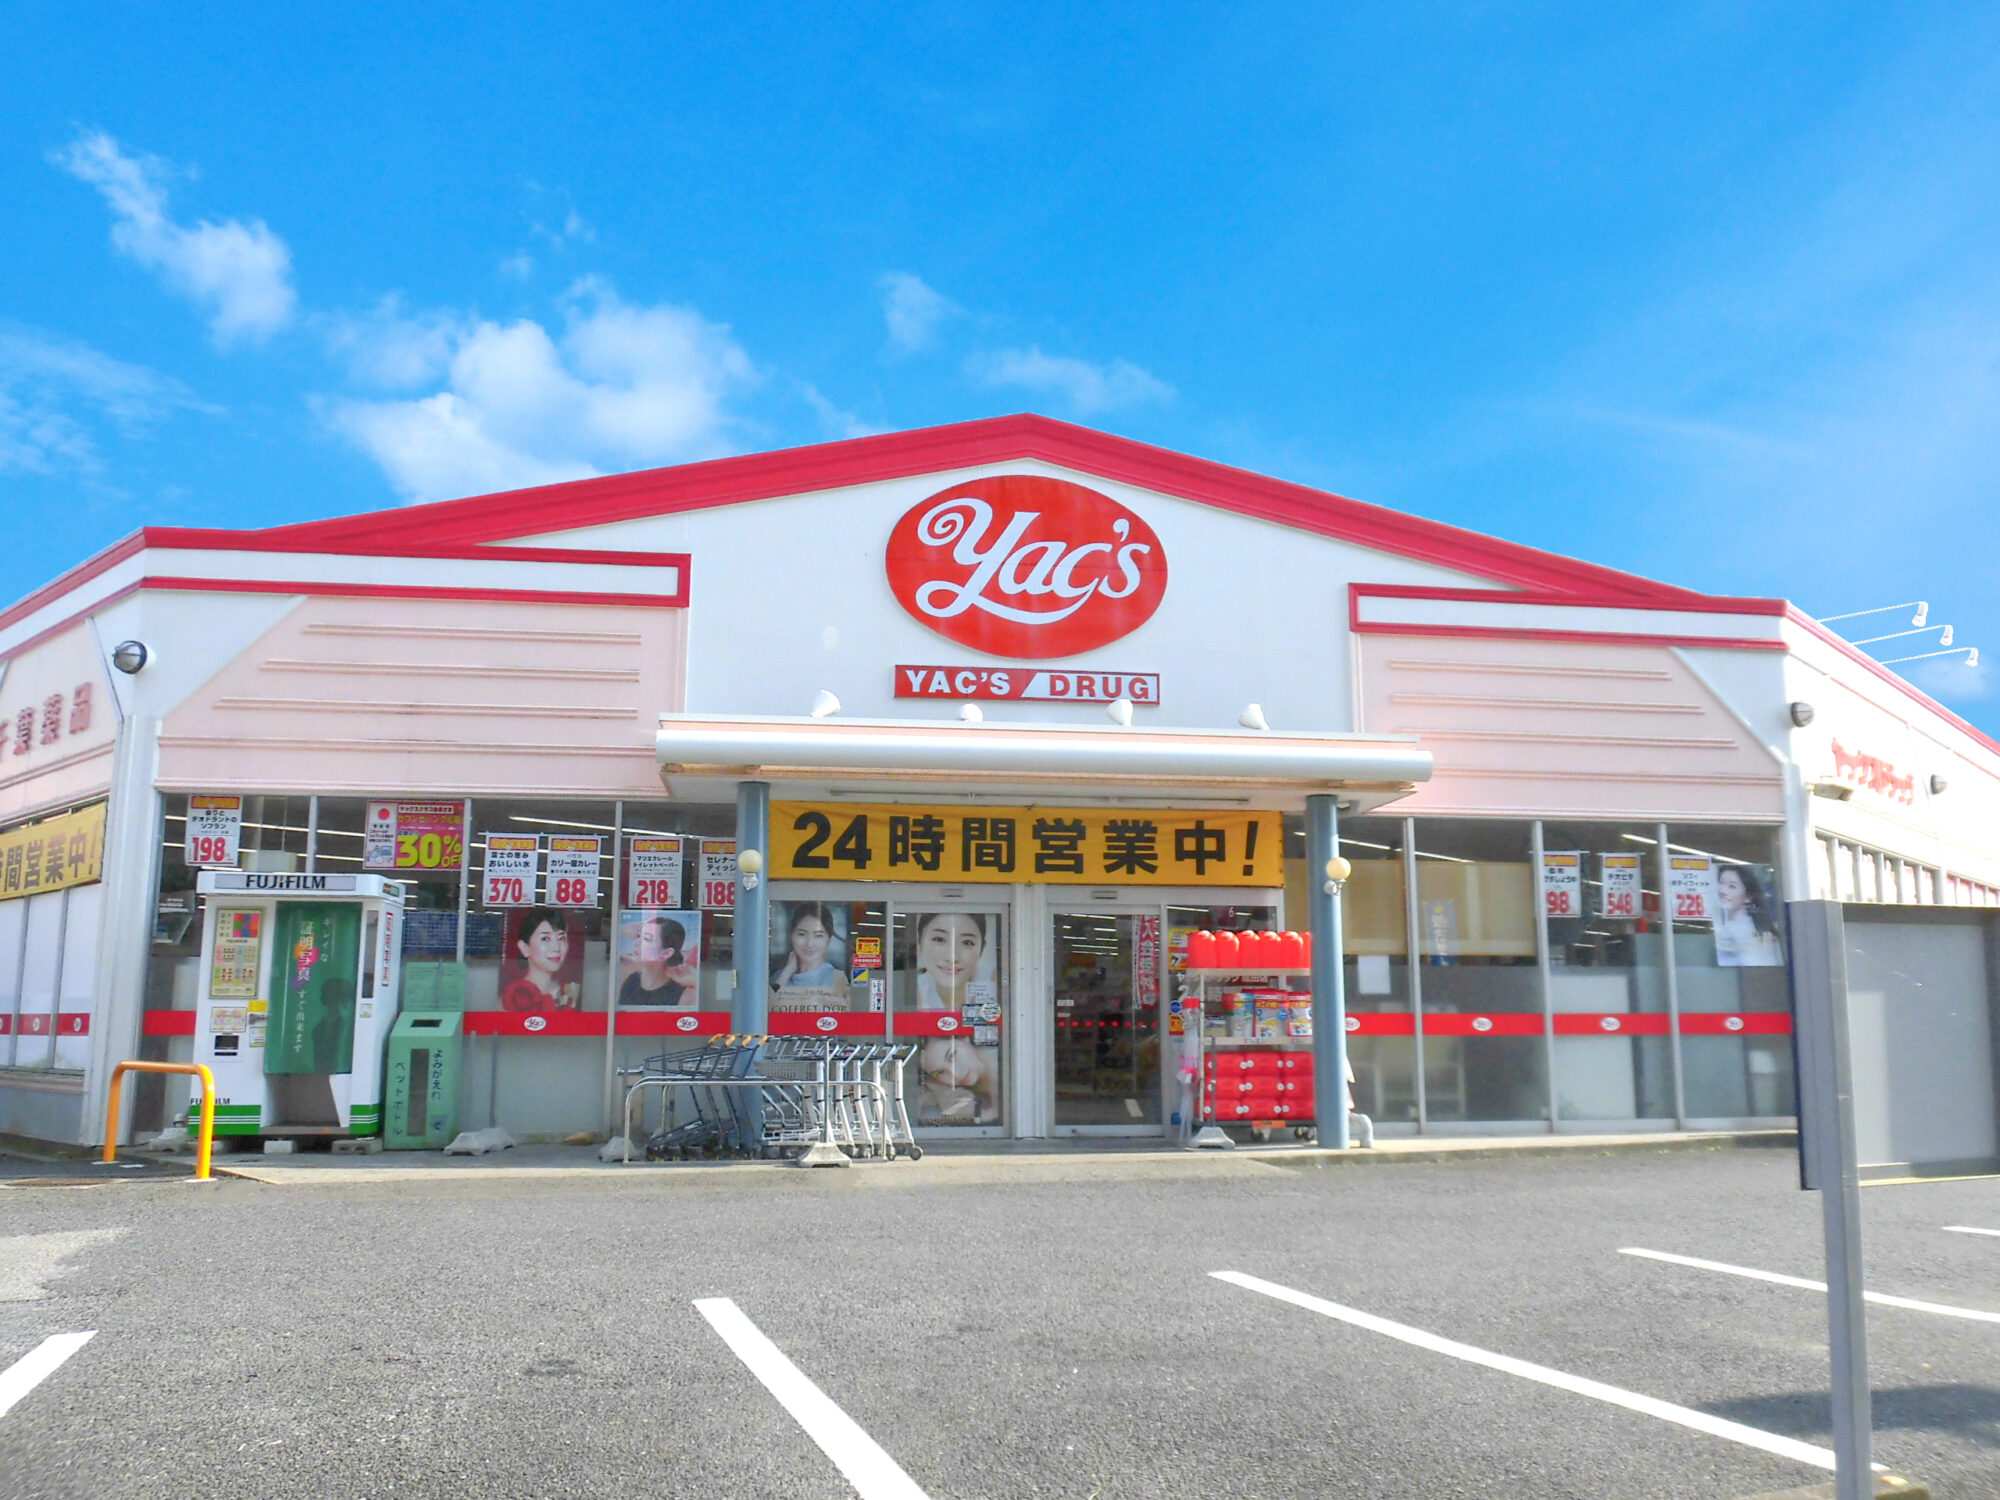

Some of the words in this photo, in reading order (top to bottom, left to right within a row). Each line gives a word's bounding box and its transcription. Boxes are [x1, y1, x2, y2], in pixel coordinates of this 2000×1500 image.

[915, 497, 1150, 625] Yac's
[905, 670, 1010, 695] YAC'S
[1049, 675, 1149, 699] DRUG
[0, 823, 100, 893] 間営業中!
[192, 836, 226, 861] 198
[396, 833, 462, 868] 30%
[488, 860, 531, 868] おいしい水
[246, 875, 326, 889] FUJIFILM
[489, 878, 523, 902] 370
[556, 879, 586, 903] 88
[636, 880, 669, 903] 218
[1546, 891, 1570, 913] 98
[1607, 892, 1633, 914] 548
[1676, 893, 1705, 916] 228
[298, 920, 315, 981] 証明写真
[432, 1049, 443, 1100] よみがえれ
[190, 1097, 231, 1105] FUILM
